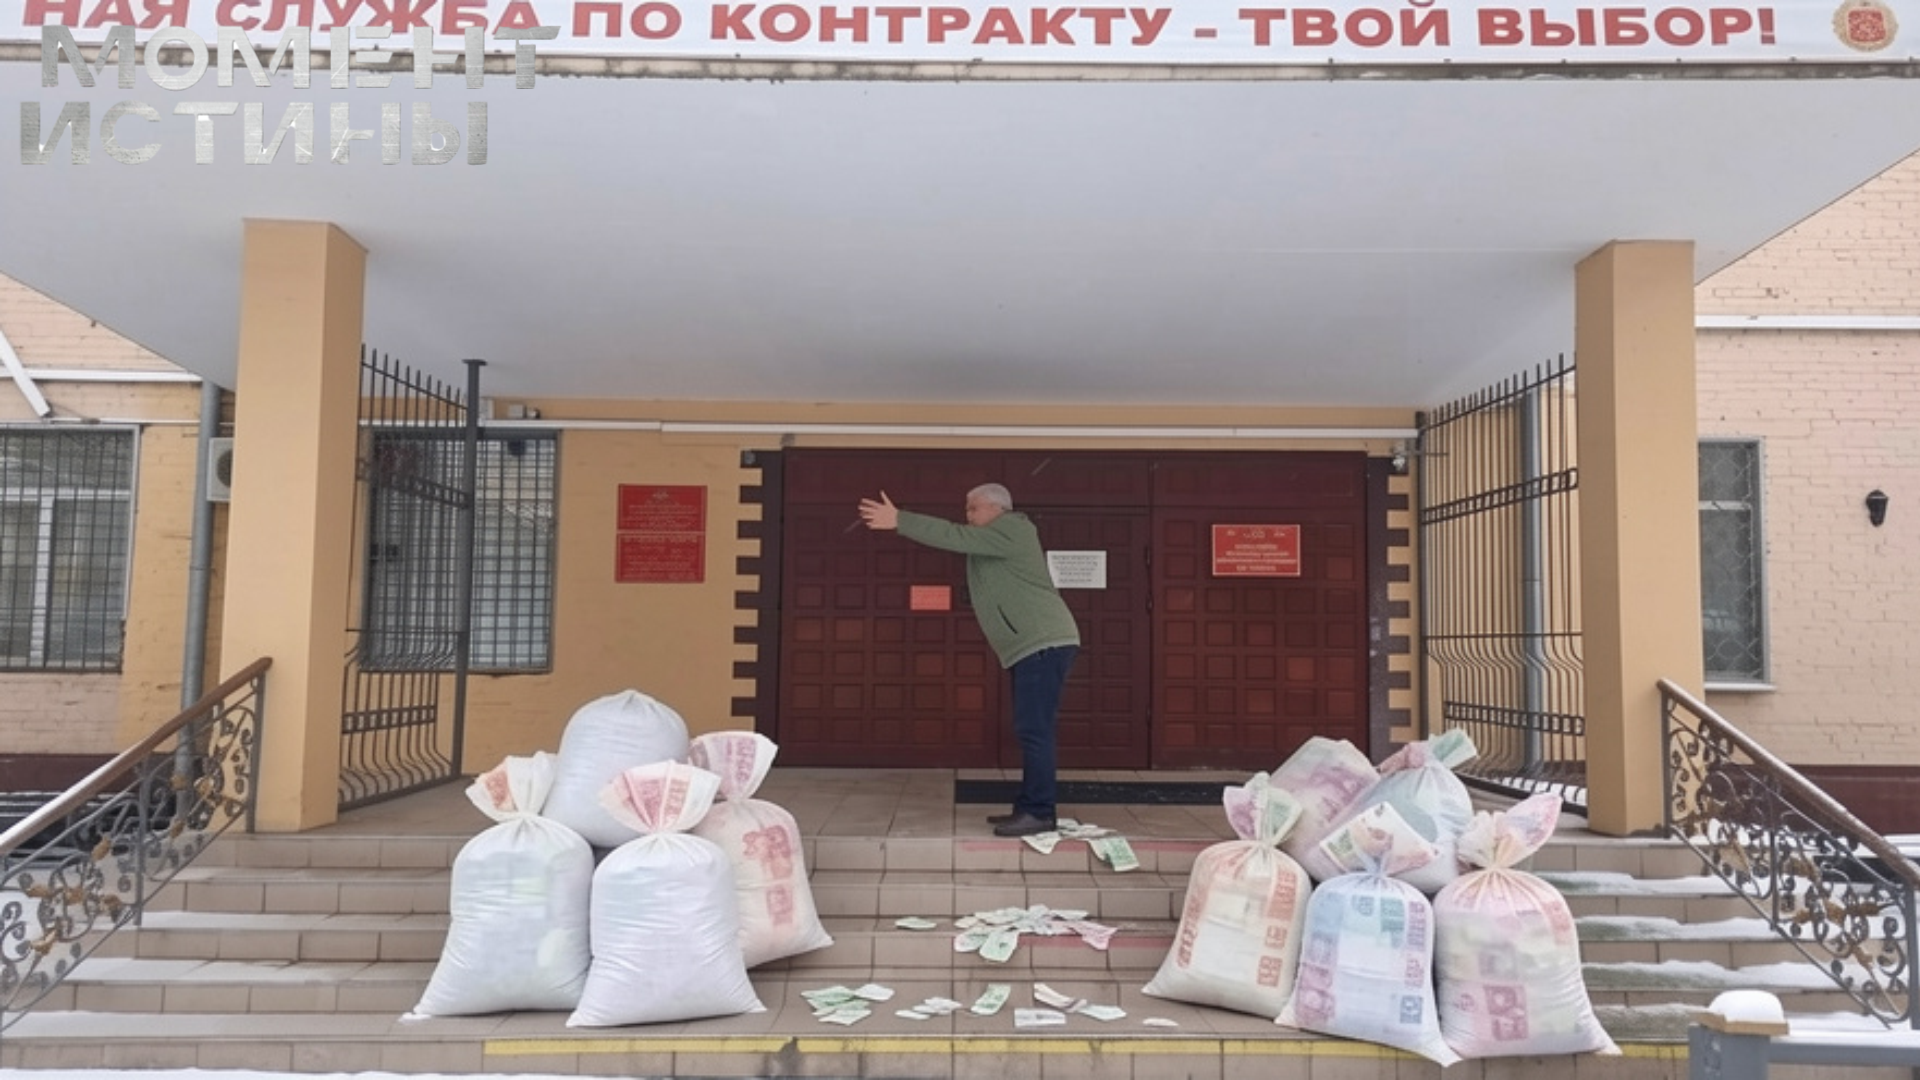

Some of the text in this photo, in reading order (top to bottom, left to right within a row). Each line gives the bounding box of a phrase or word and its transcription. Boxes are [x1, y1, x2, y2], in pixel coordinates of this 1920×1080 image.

[22, 0, 1776, 46] НАЯ СЛУЖБА ПО КОНТРАКТУ - ТВОЙ ВЫБОР!
